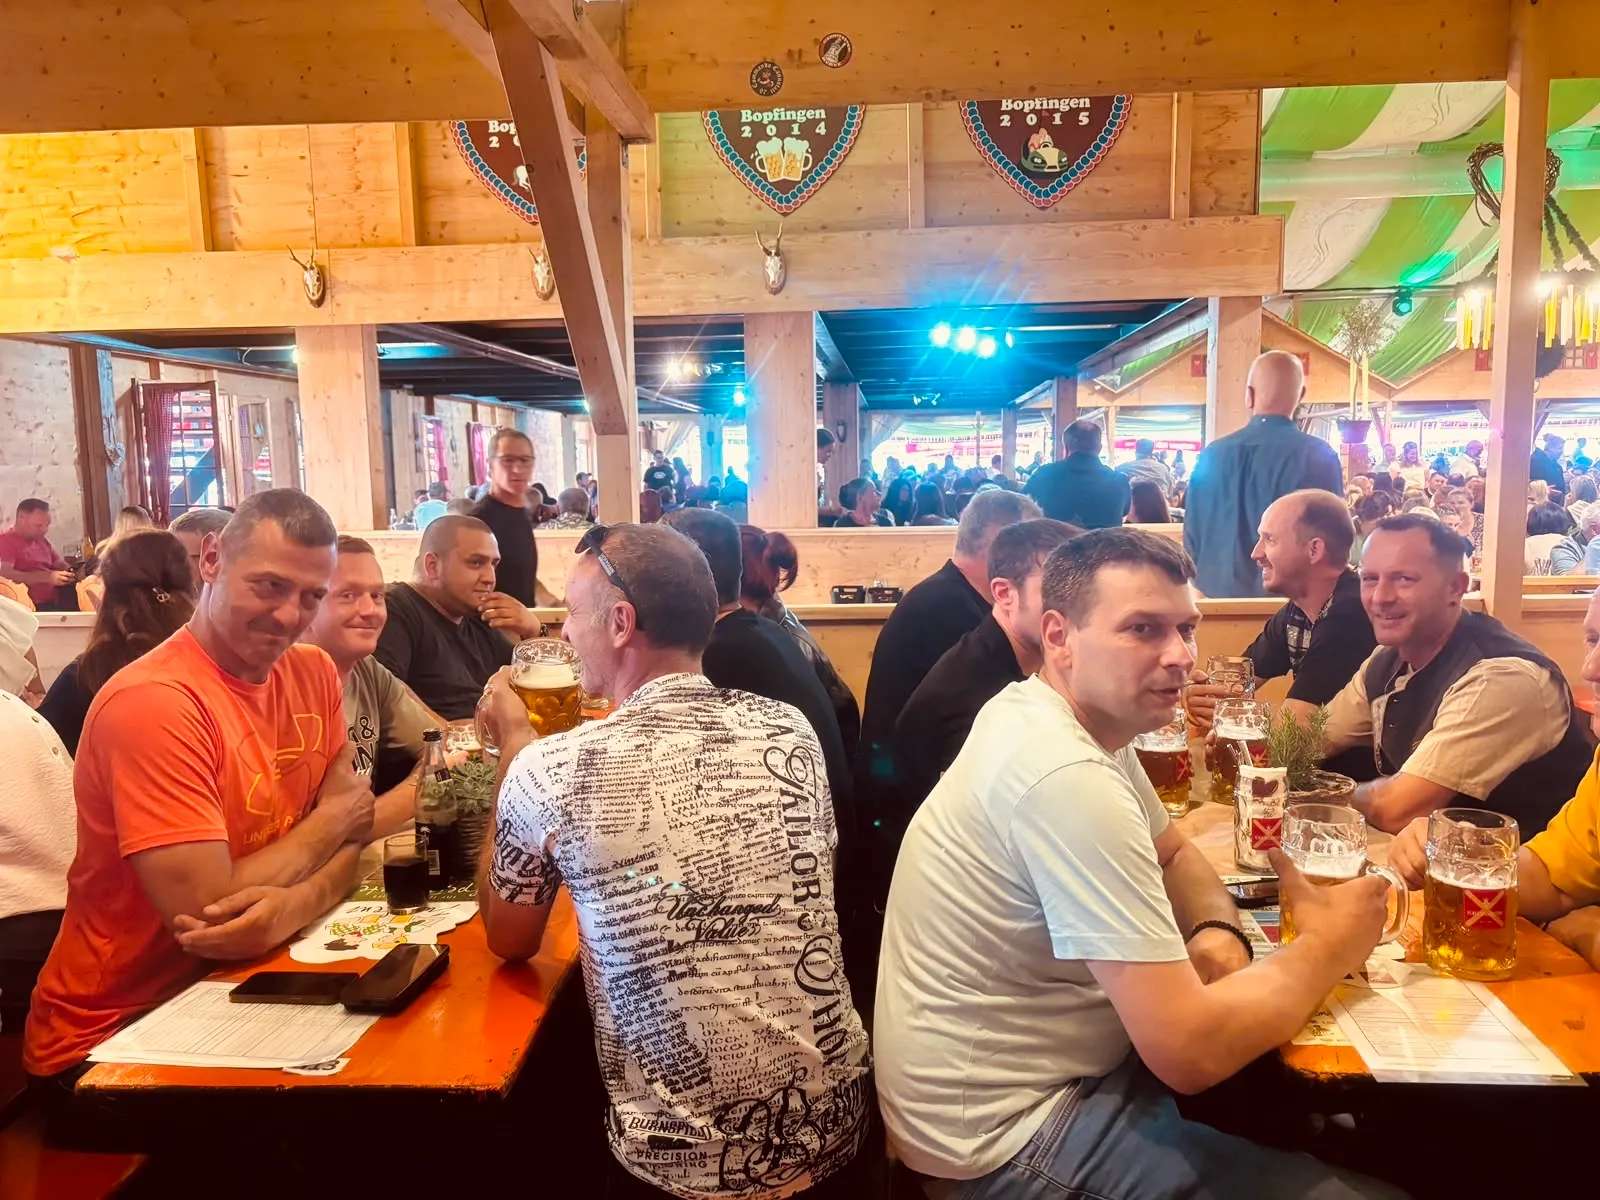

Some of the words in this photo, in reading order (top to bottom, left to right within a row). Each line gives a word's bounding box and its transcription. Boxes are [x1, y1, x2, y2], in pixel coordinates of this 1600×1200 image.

[1001, 97, 1091, 113] Bopfingen
[740, 107, 826, 124] Bopfingen
[636, 1151, 708, 1161] PRECISION
